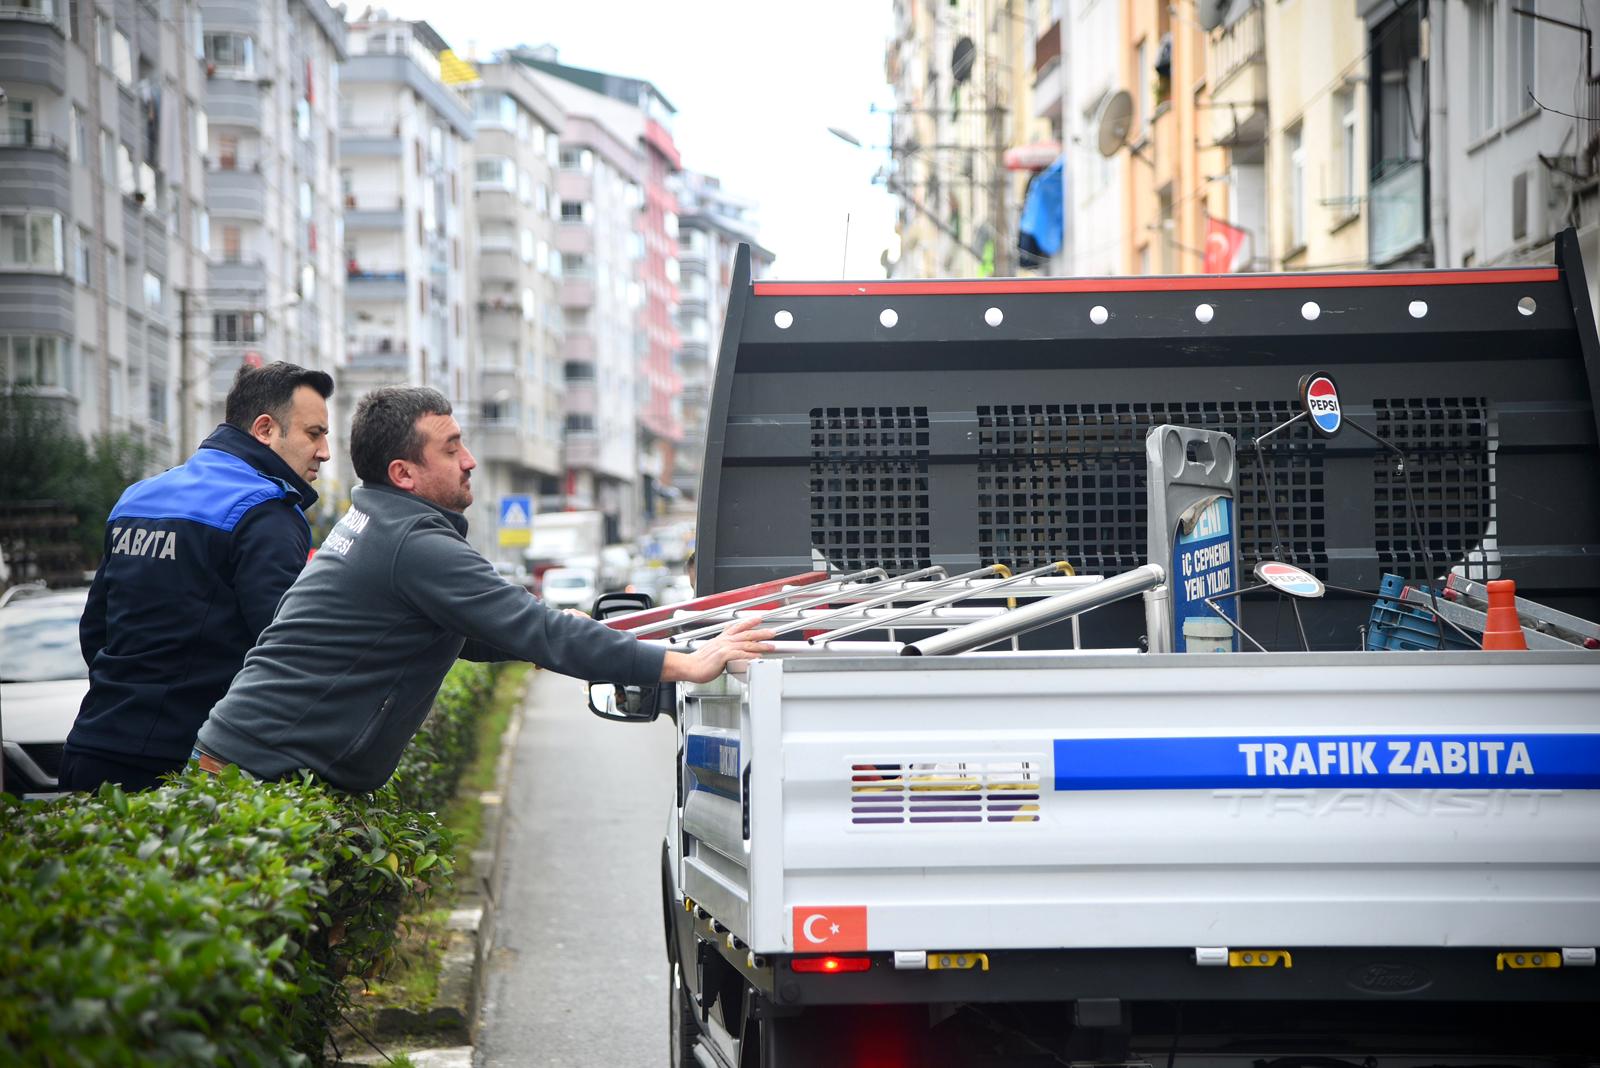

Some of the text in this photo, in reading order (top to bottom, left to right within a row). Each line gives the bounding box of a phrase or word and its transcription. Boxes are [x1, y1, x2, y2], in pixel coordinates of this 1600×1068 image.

[1310, 399, 1338, 412] PEPSI
[112, 527, 176, 560] ZABITA
[1268, 575, 1312, 583] PEPSI
[1238, 741, 1535, 776] TRAFIK ZABITA
[1212, 788, 1564, 818] TRANSIT
